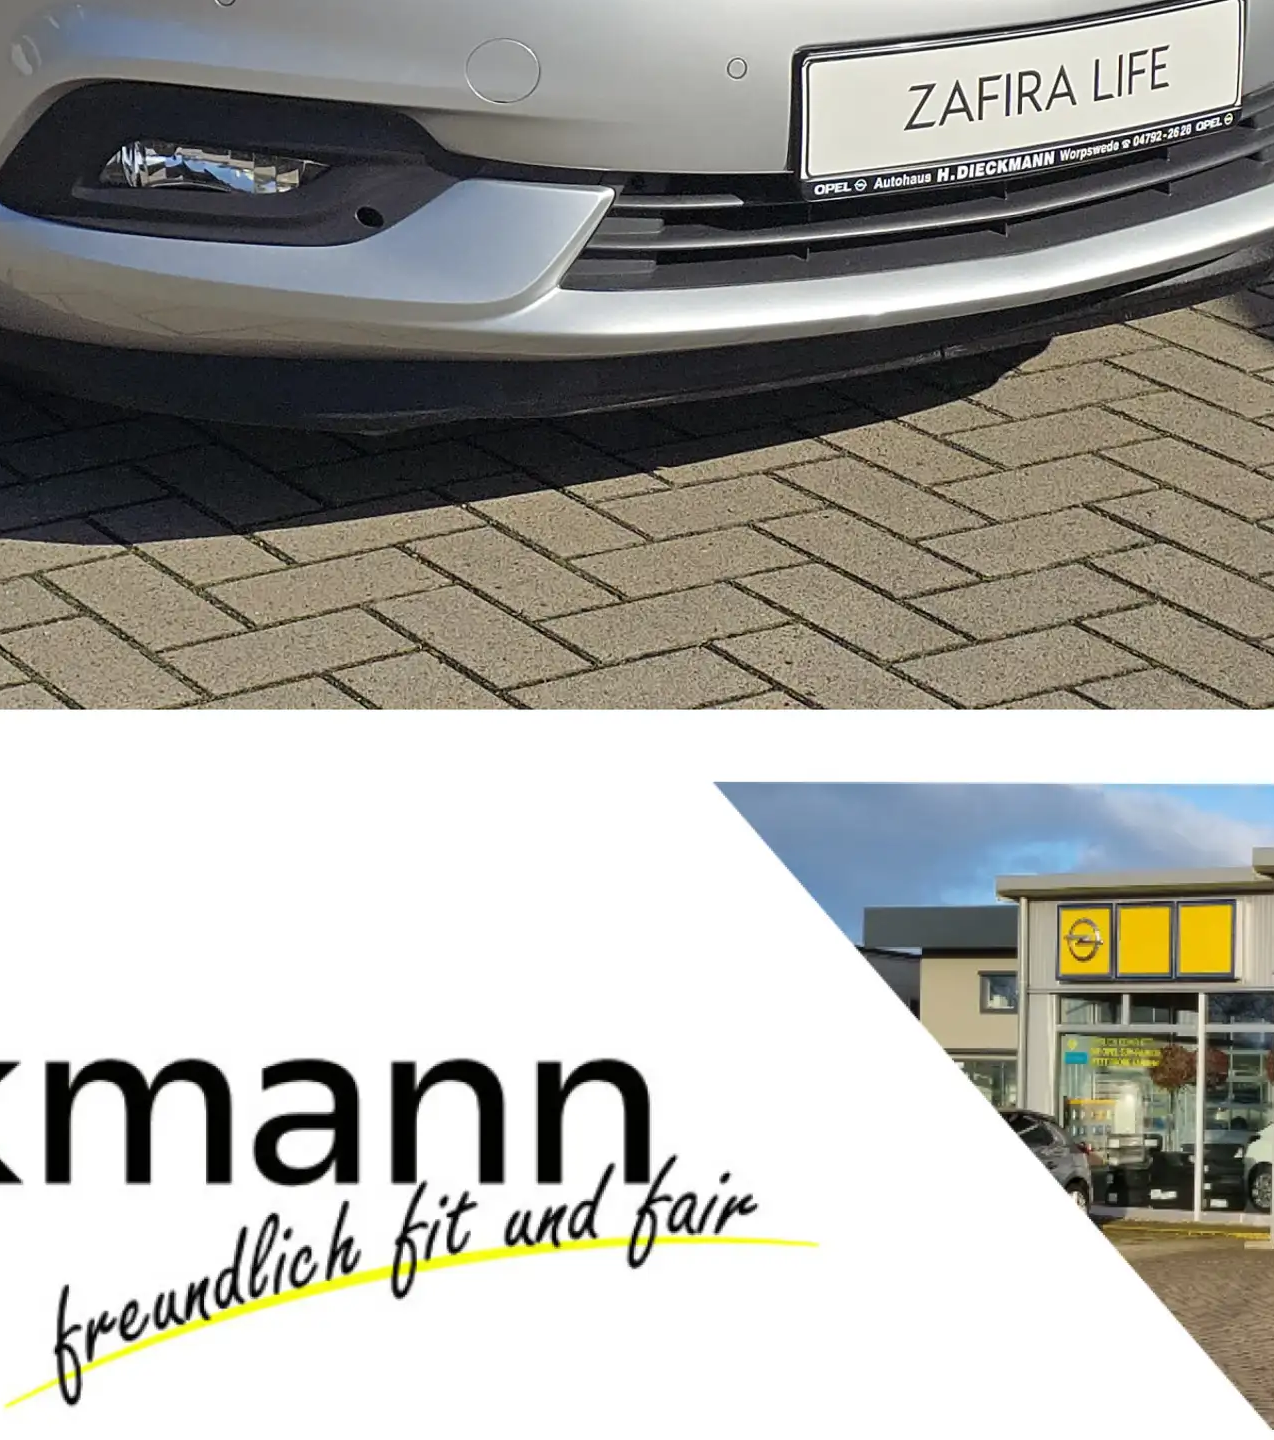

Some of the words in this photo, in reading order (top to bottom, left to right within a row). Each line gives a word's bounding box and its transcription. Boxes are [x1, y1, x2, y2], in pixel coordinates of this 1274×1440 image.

[904, 65, 1077, 131] ZAFIRA
[1093, 44, 1170, 102] LIFE
[814, 181, 852, 196] OPEL
[873, 171, 932, 190] Autohaus
[936, 150, 1056, 184] H.DIECKMANN
[1060, 139, 1120, 163] Worpswede
[1195, 116, 1223, 132] OPEL
